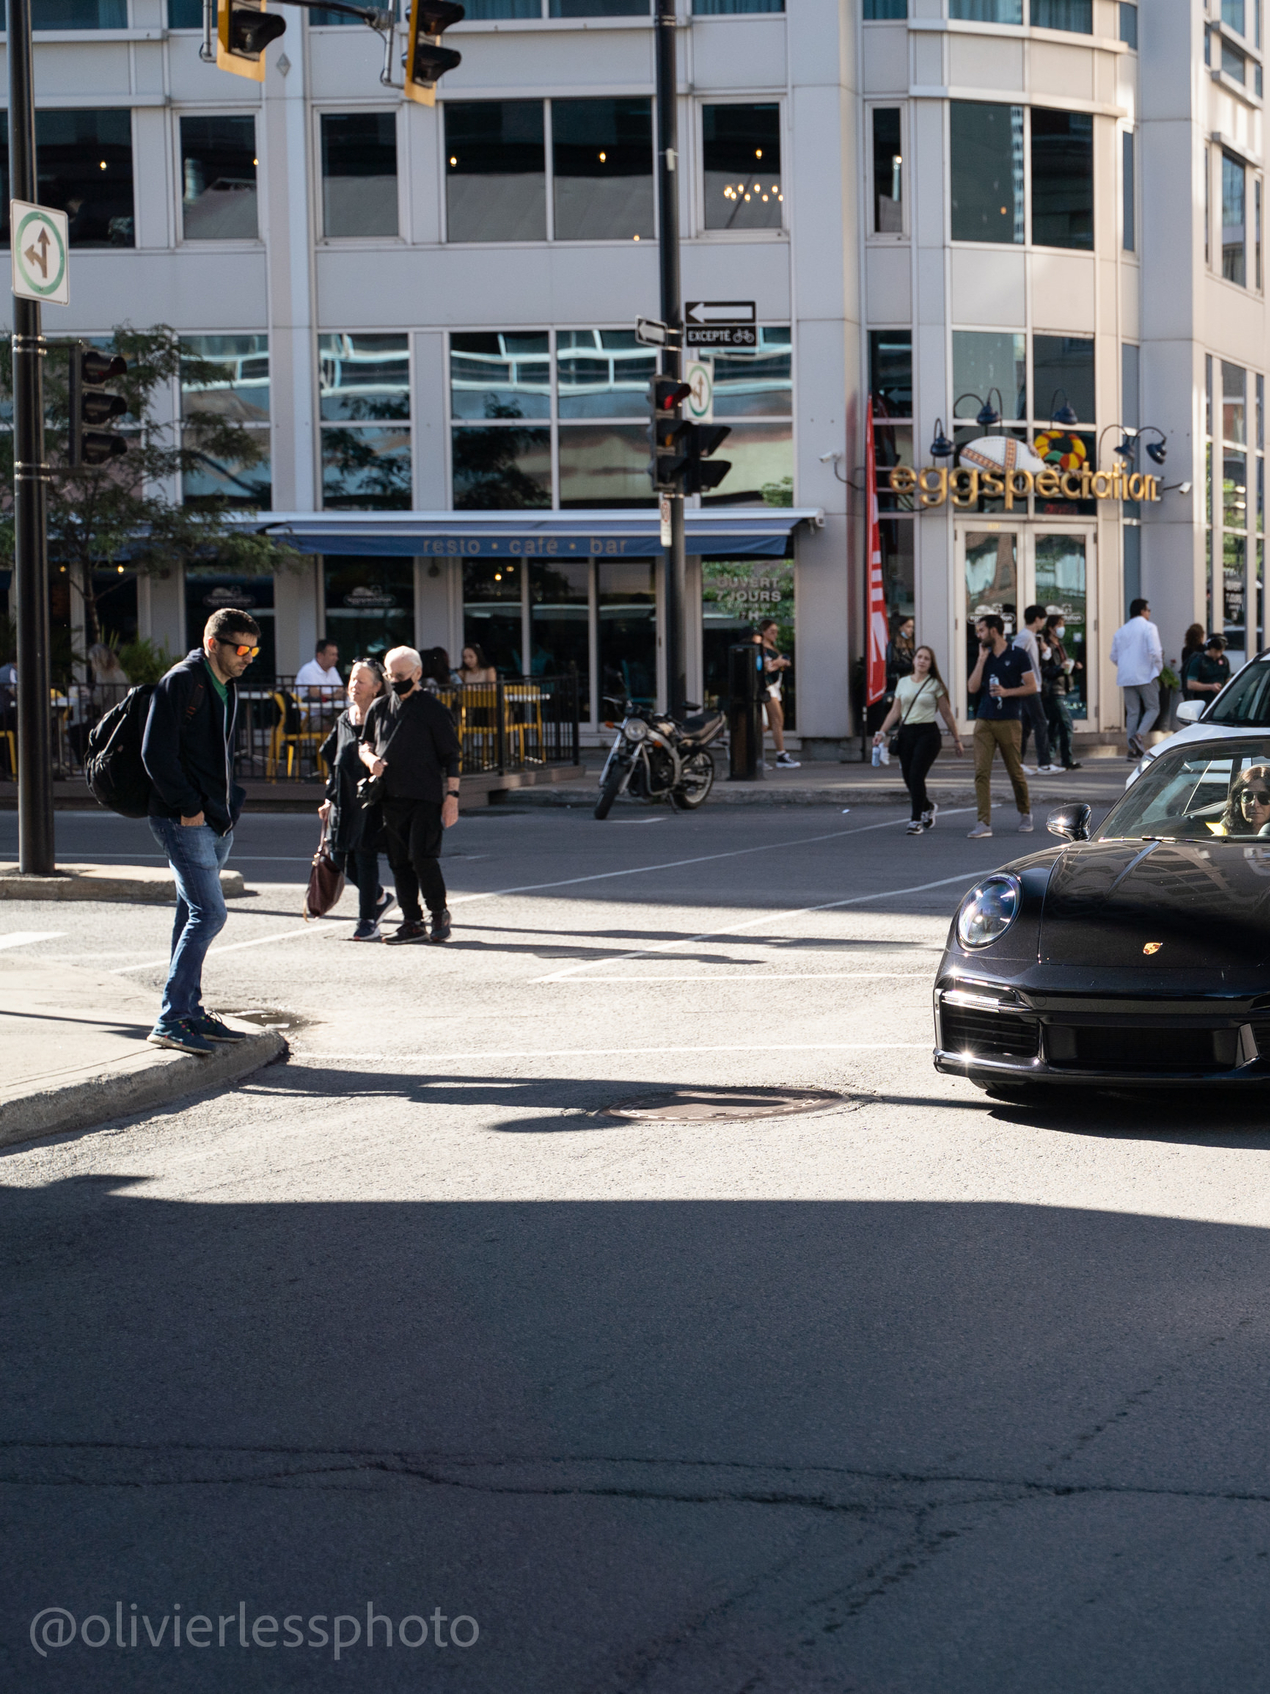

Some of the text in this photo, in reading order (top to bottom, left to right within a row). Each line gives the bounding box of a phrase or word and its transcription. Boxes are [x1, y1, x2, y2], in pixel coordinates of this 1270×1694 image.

[687, 328, 732, 342] EXCEPTÉ
[889, 460, 1157, 511] eggspectation
[423, 536, 628, 555] resto café bar
[716, 576, 779, 588] OUVERT
[716, 590, 782, 602] 7 JOURS
